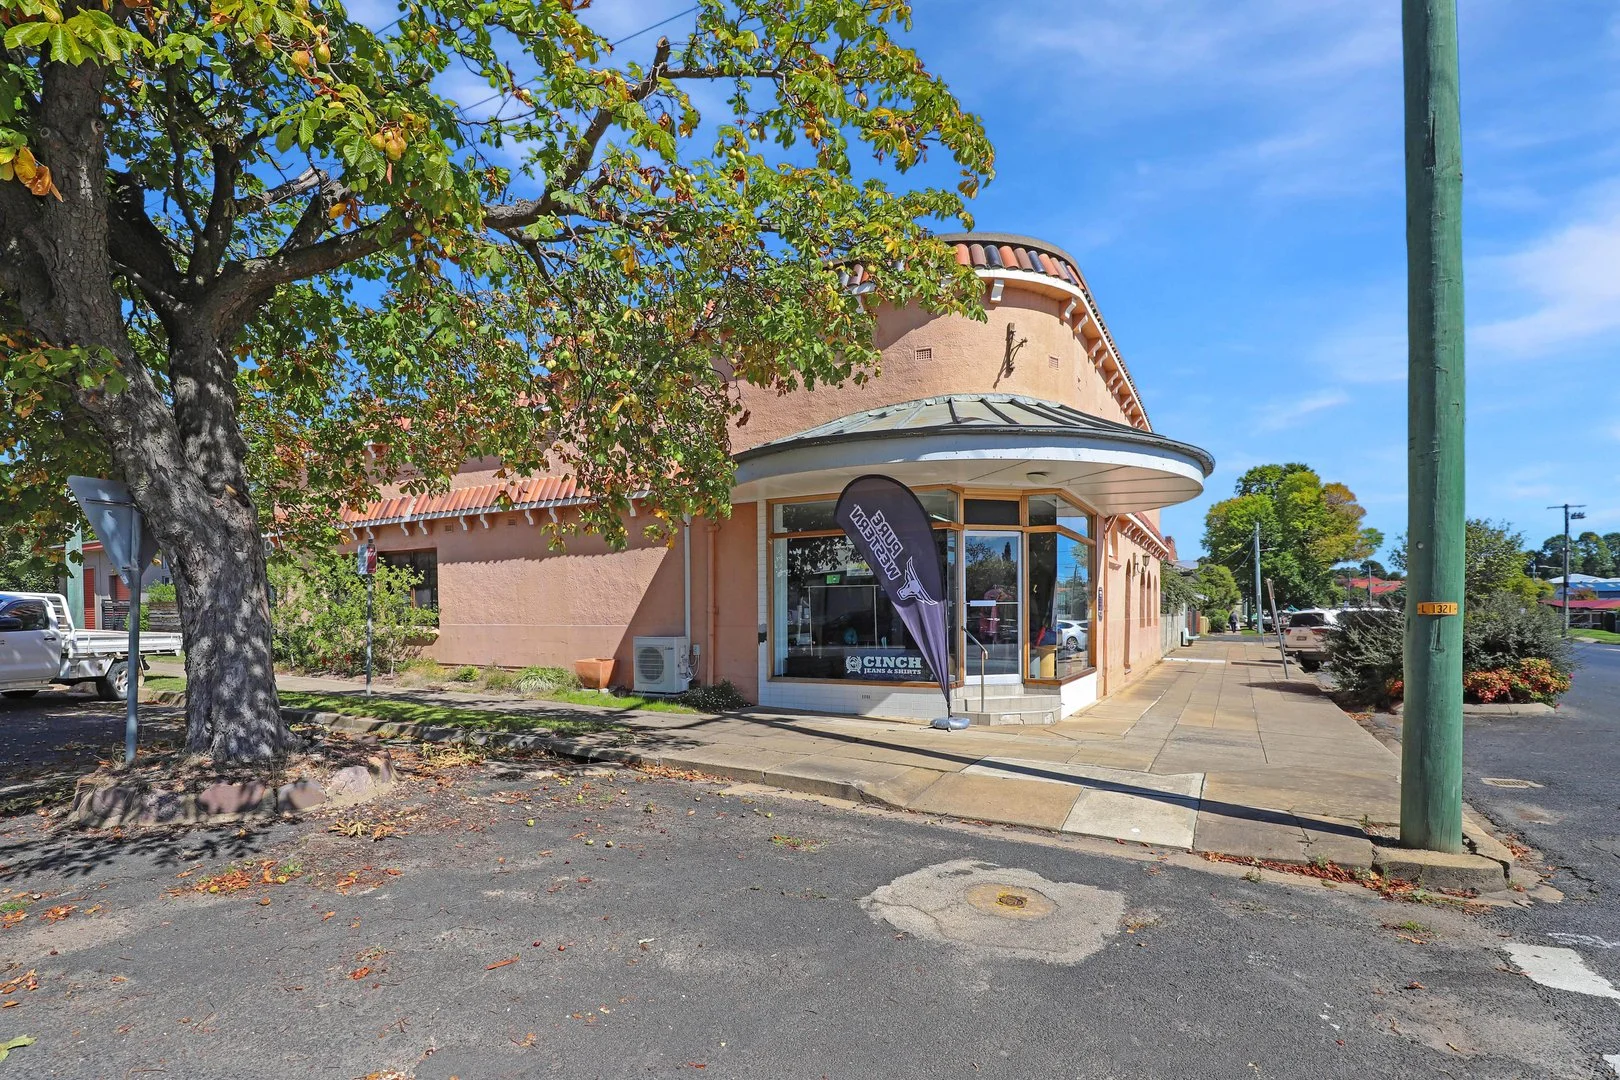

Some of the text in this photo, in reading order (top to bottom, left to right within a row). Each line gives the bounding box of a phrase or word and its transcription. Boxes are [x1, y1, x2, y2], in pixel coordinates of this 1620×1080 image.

[1421, 604, 1452, 613] L 1321
[863, 656, 921, 668] CINCH
